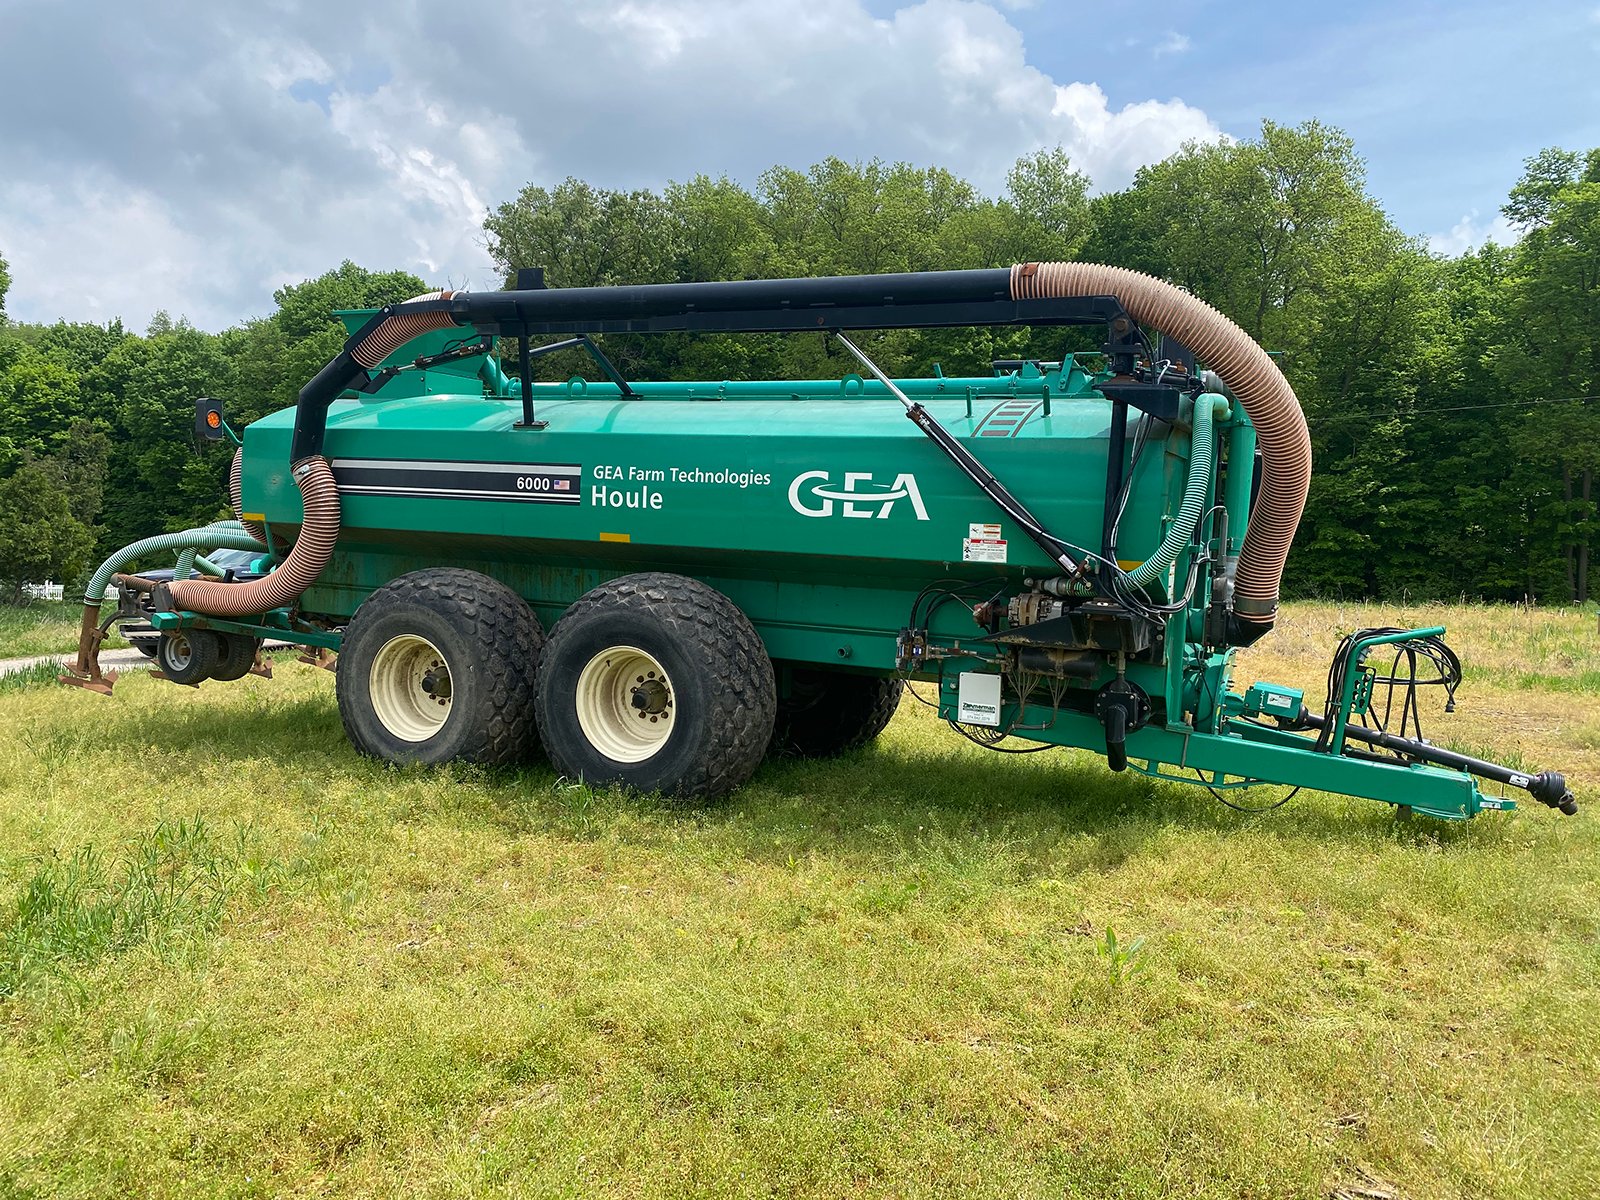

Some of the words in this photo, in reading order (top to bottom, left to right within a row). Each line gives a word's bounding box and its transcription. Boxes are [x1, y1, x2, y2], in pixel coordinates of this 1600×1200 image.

[516, 476, 550, 491] 6000
[593, 465, 623, 480] GEA
[629, 467, 665, 482] Farm
[670, 468, 771, 488] Technologies
[591, 485, 663, 510] Houle
[788, 470, 930, 521] GEA
